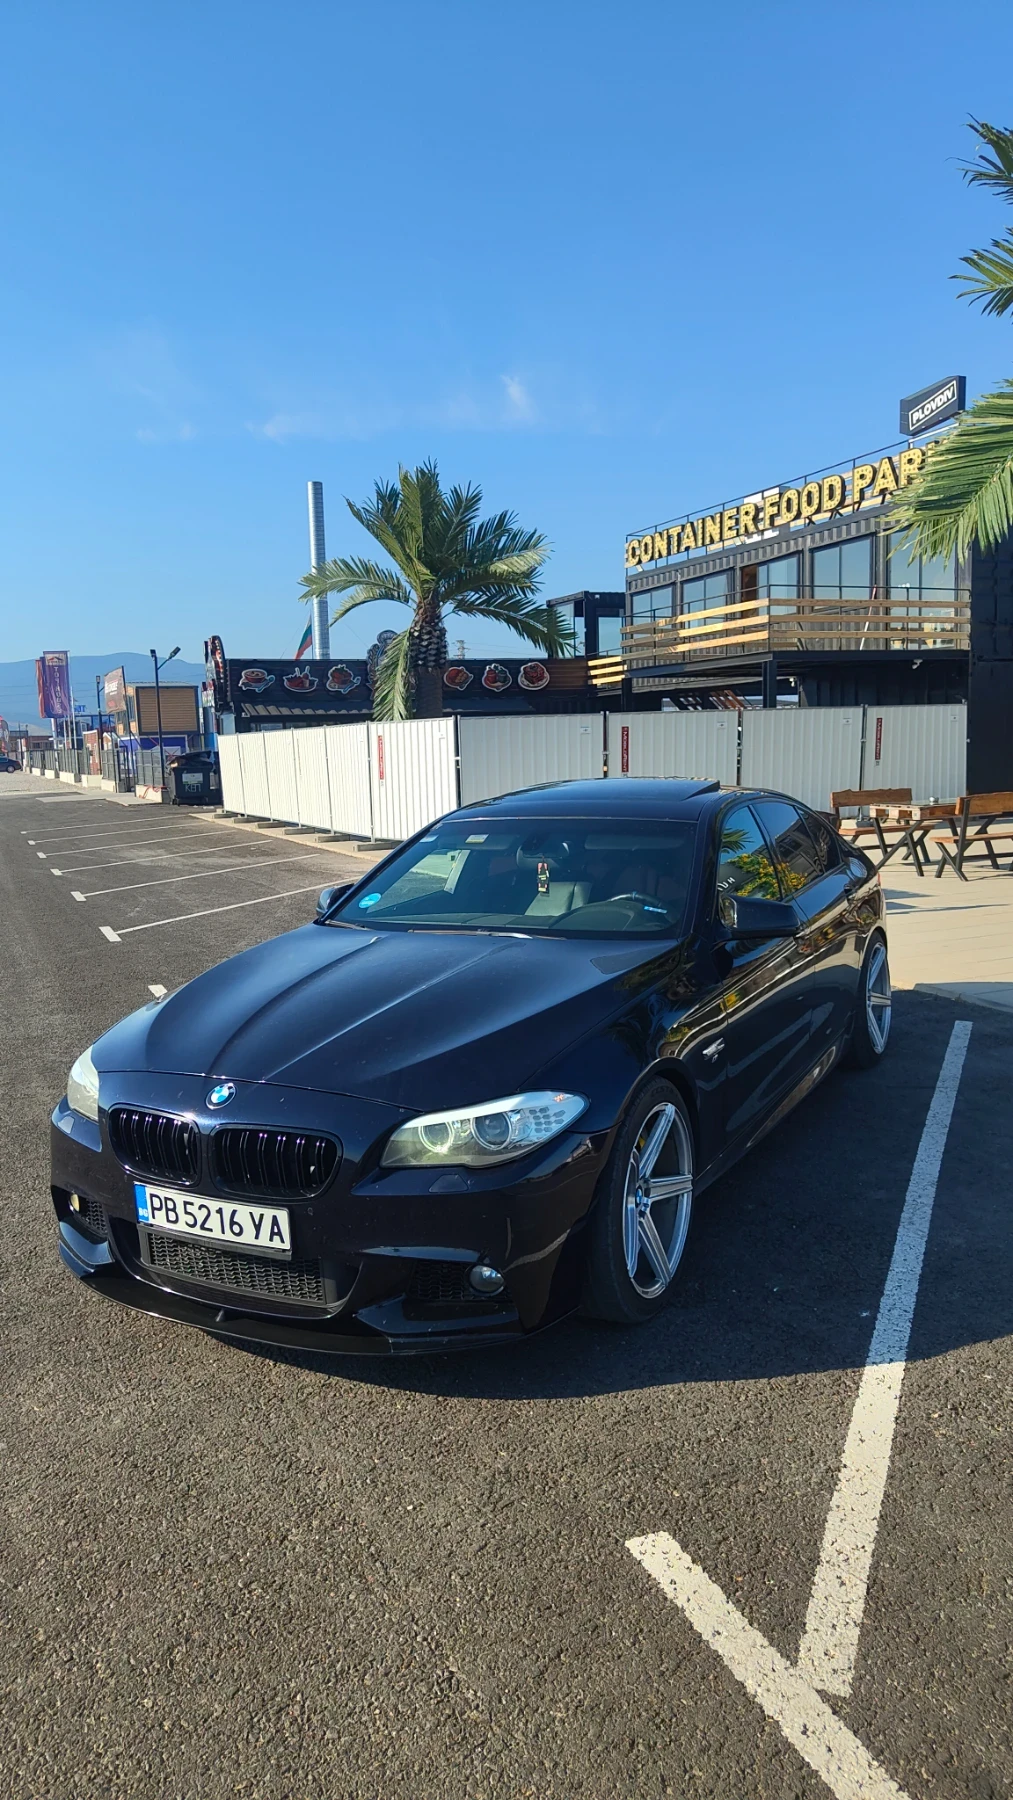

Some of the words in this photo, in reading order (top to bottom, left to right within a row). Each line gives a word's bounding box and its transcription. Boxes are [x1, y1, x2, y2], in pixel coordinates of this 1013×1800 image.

[912, 386, 954, 424] PLOVDIV
[626, 502, 758, 566] CONTAINER
[763, 474, 846, 529] FOOD
